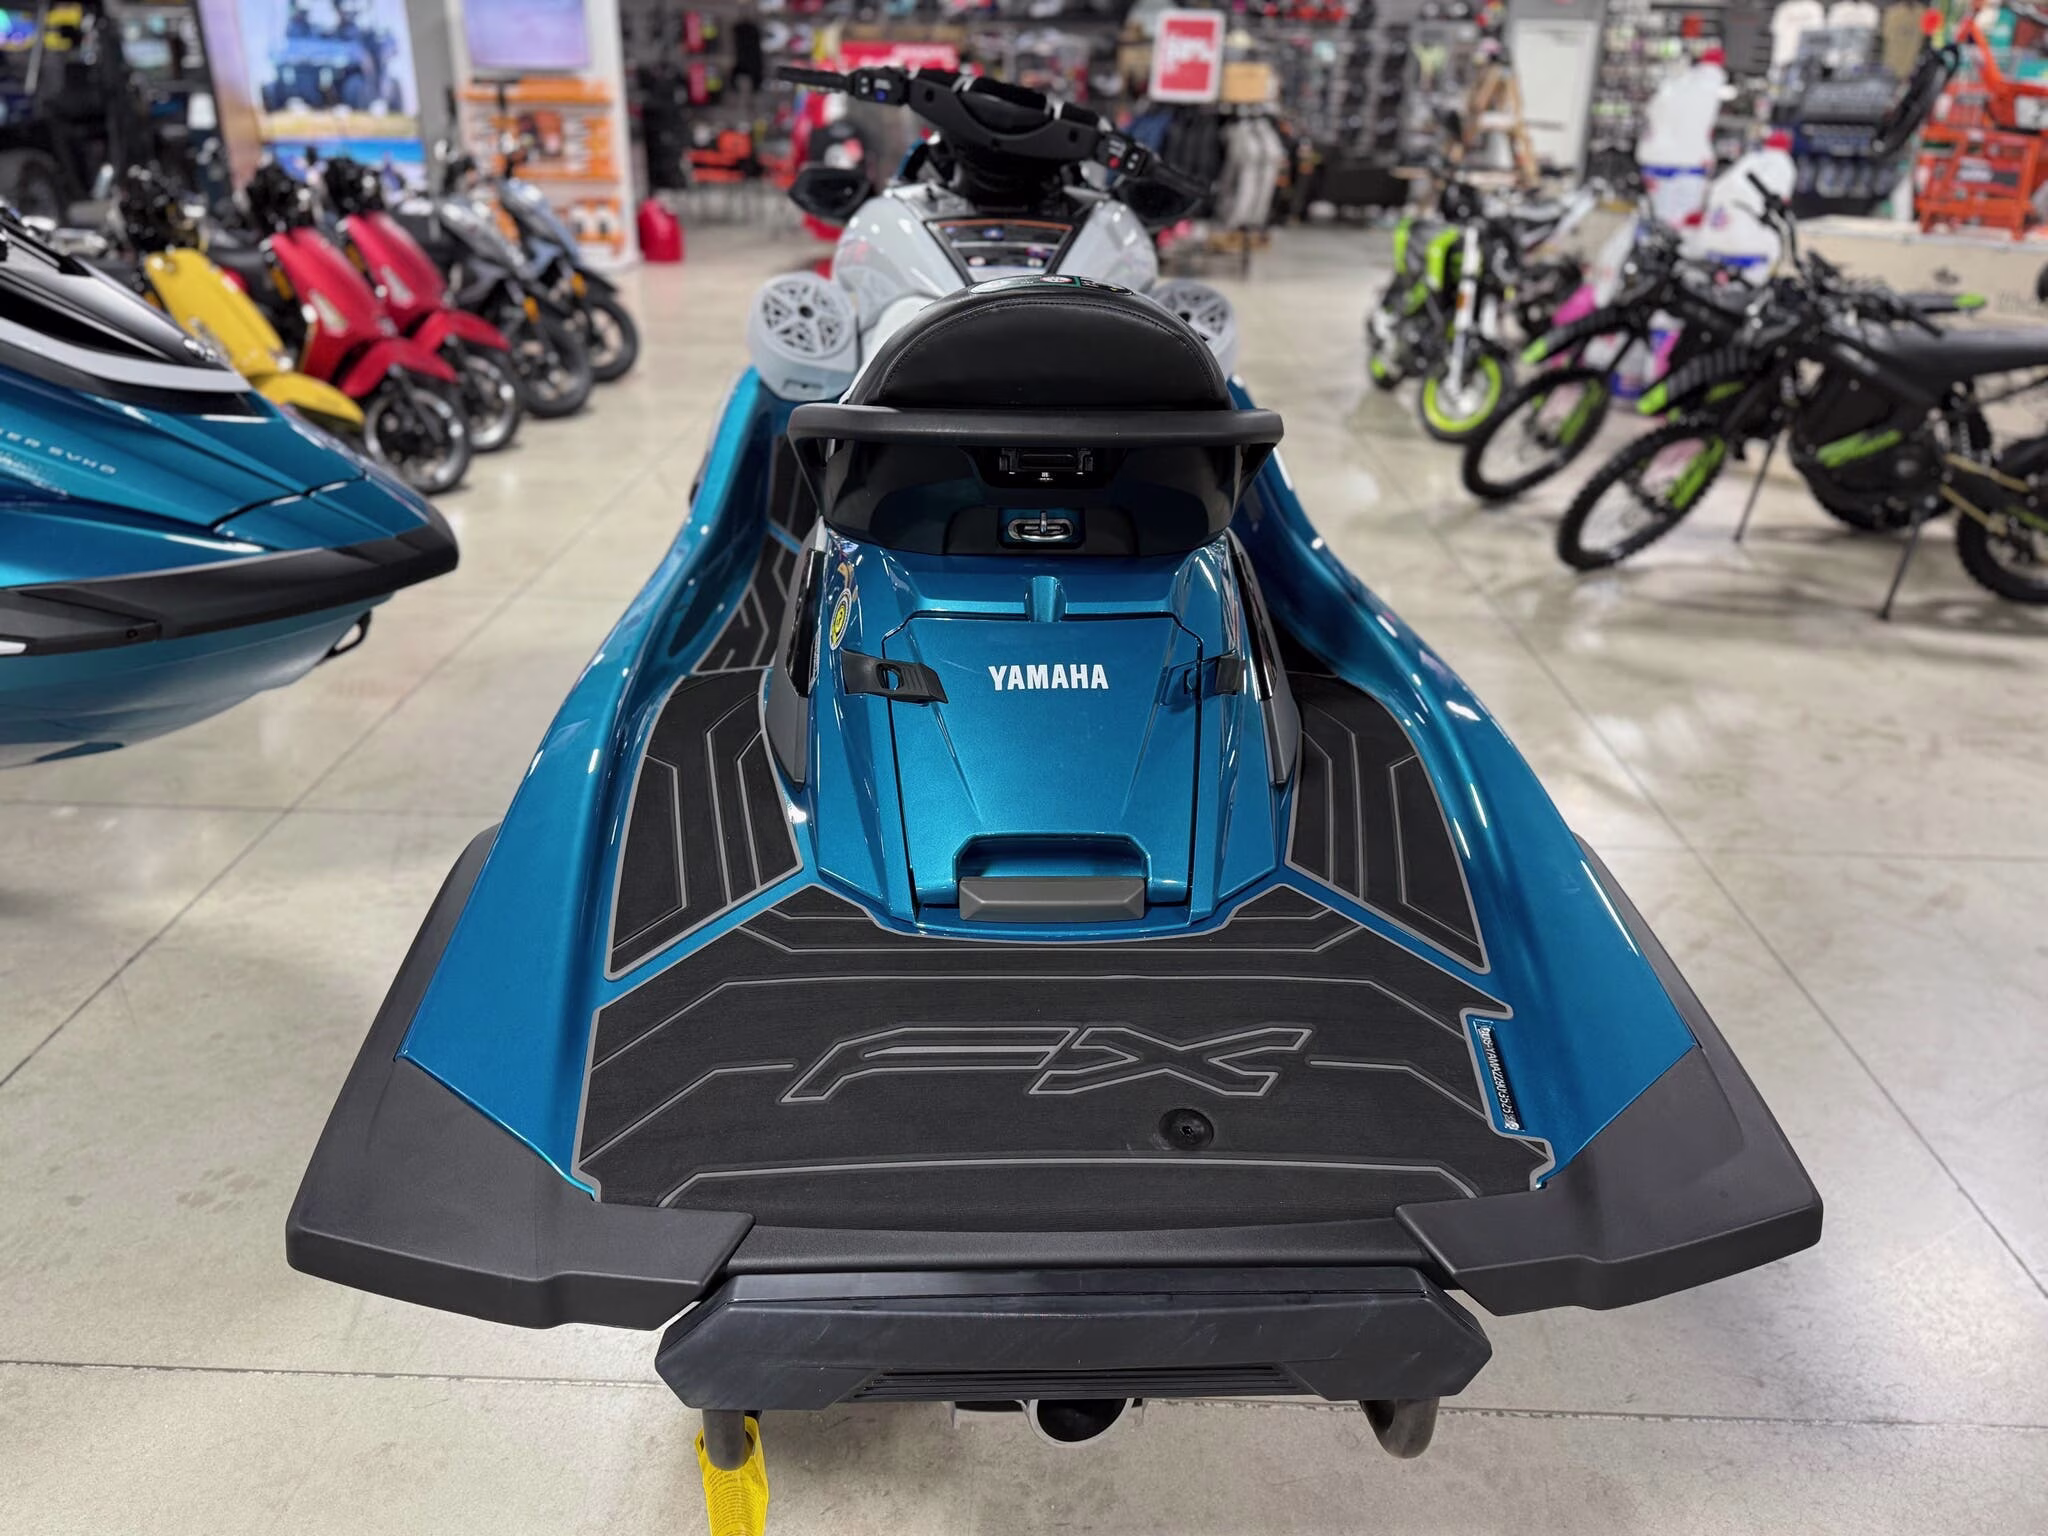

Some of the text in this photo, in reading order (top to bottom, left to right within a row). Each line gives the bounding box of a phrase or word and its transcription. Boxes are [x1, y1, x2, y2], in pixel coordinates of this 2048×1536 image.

[48, 446, 117, 475] SVHO
[987, 663, 1110, 692] YAMAHA
[780, 1026, 1314, 1103] FX
